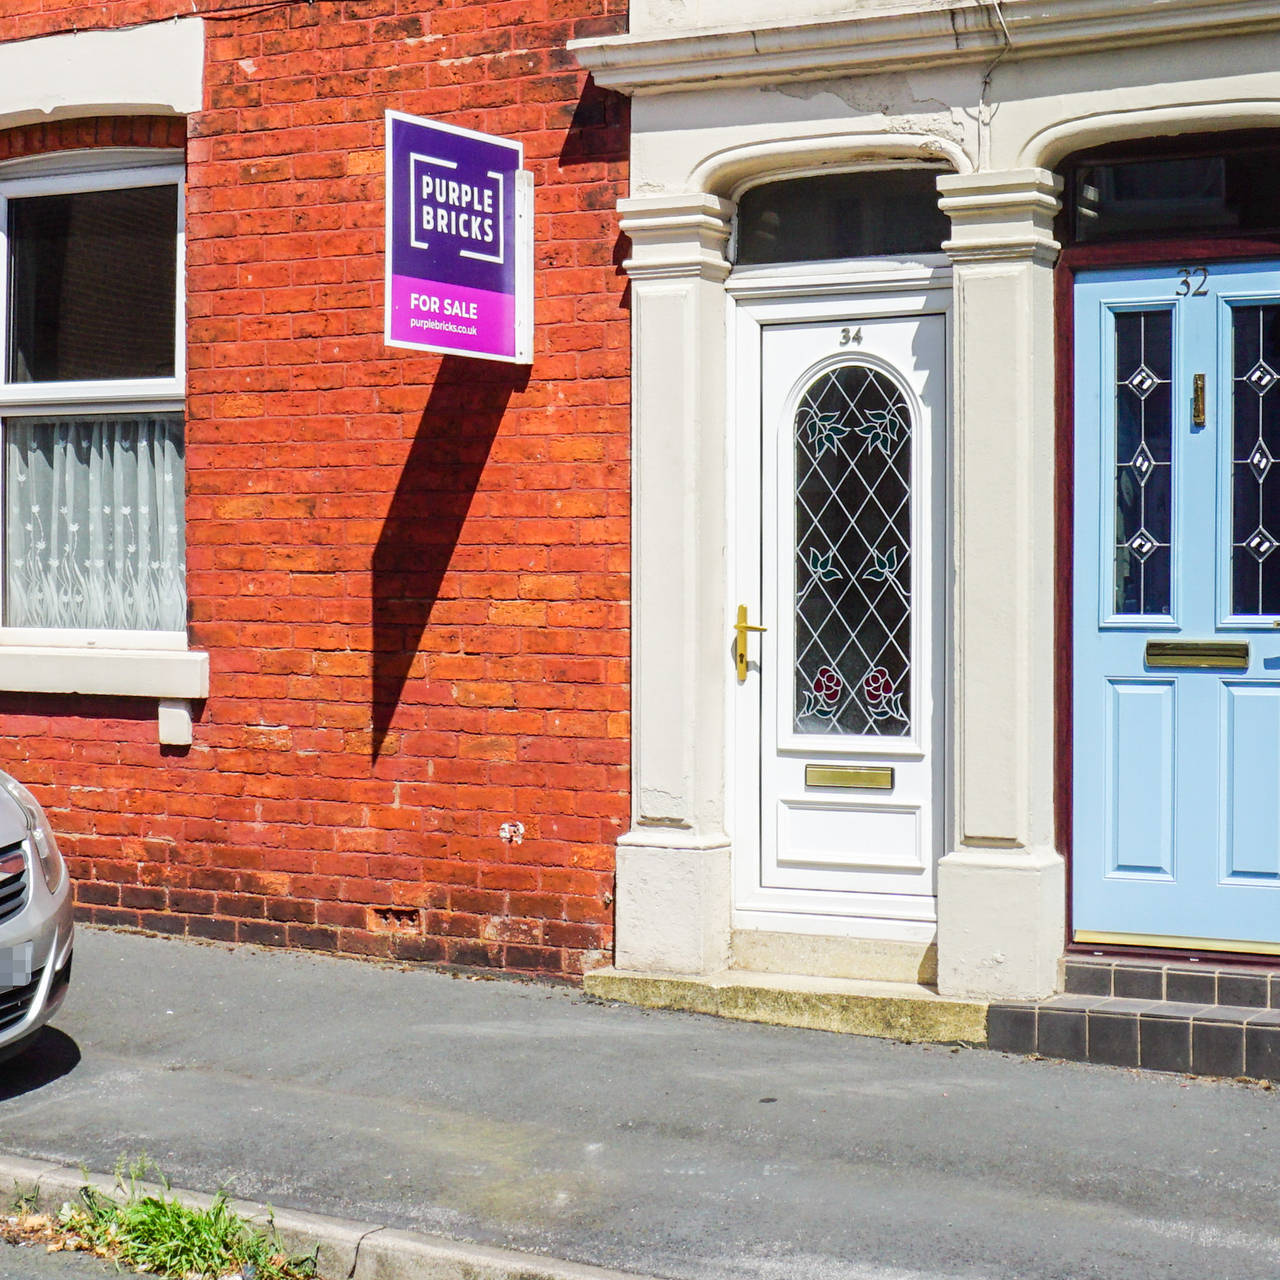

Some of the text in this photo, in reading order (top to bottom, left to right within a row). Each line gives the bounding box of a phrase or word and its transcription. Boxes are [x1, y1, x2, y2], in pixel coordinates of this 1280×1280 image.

[422, 174, 493, 214] PURPLE
[422, 205, 494, 243] BRICKS
[1175, 266, 1209, 297] 32
[410, 293, 478, 319] FOR SALE
[410, 318, 478, 335] purplebricks.co.uk
[839, 326, 863, 347] 34
